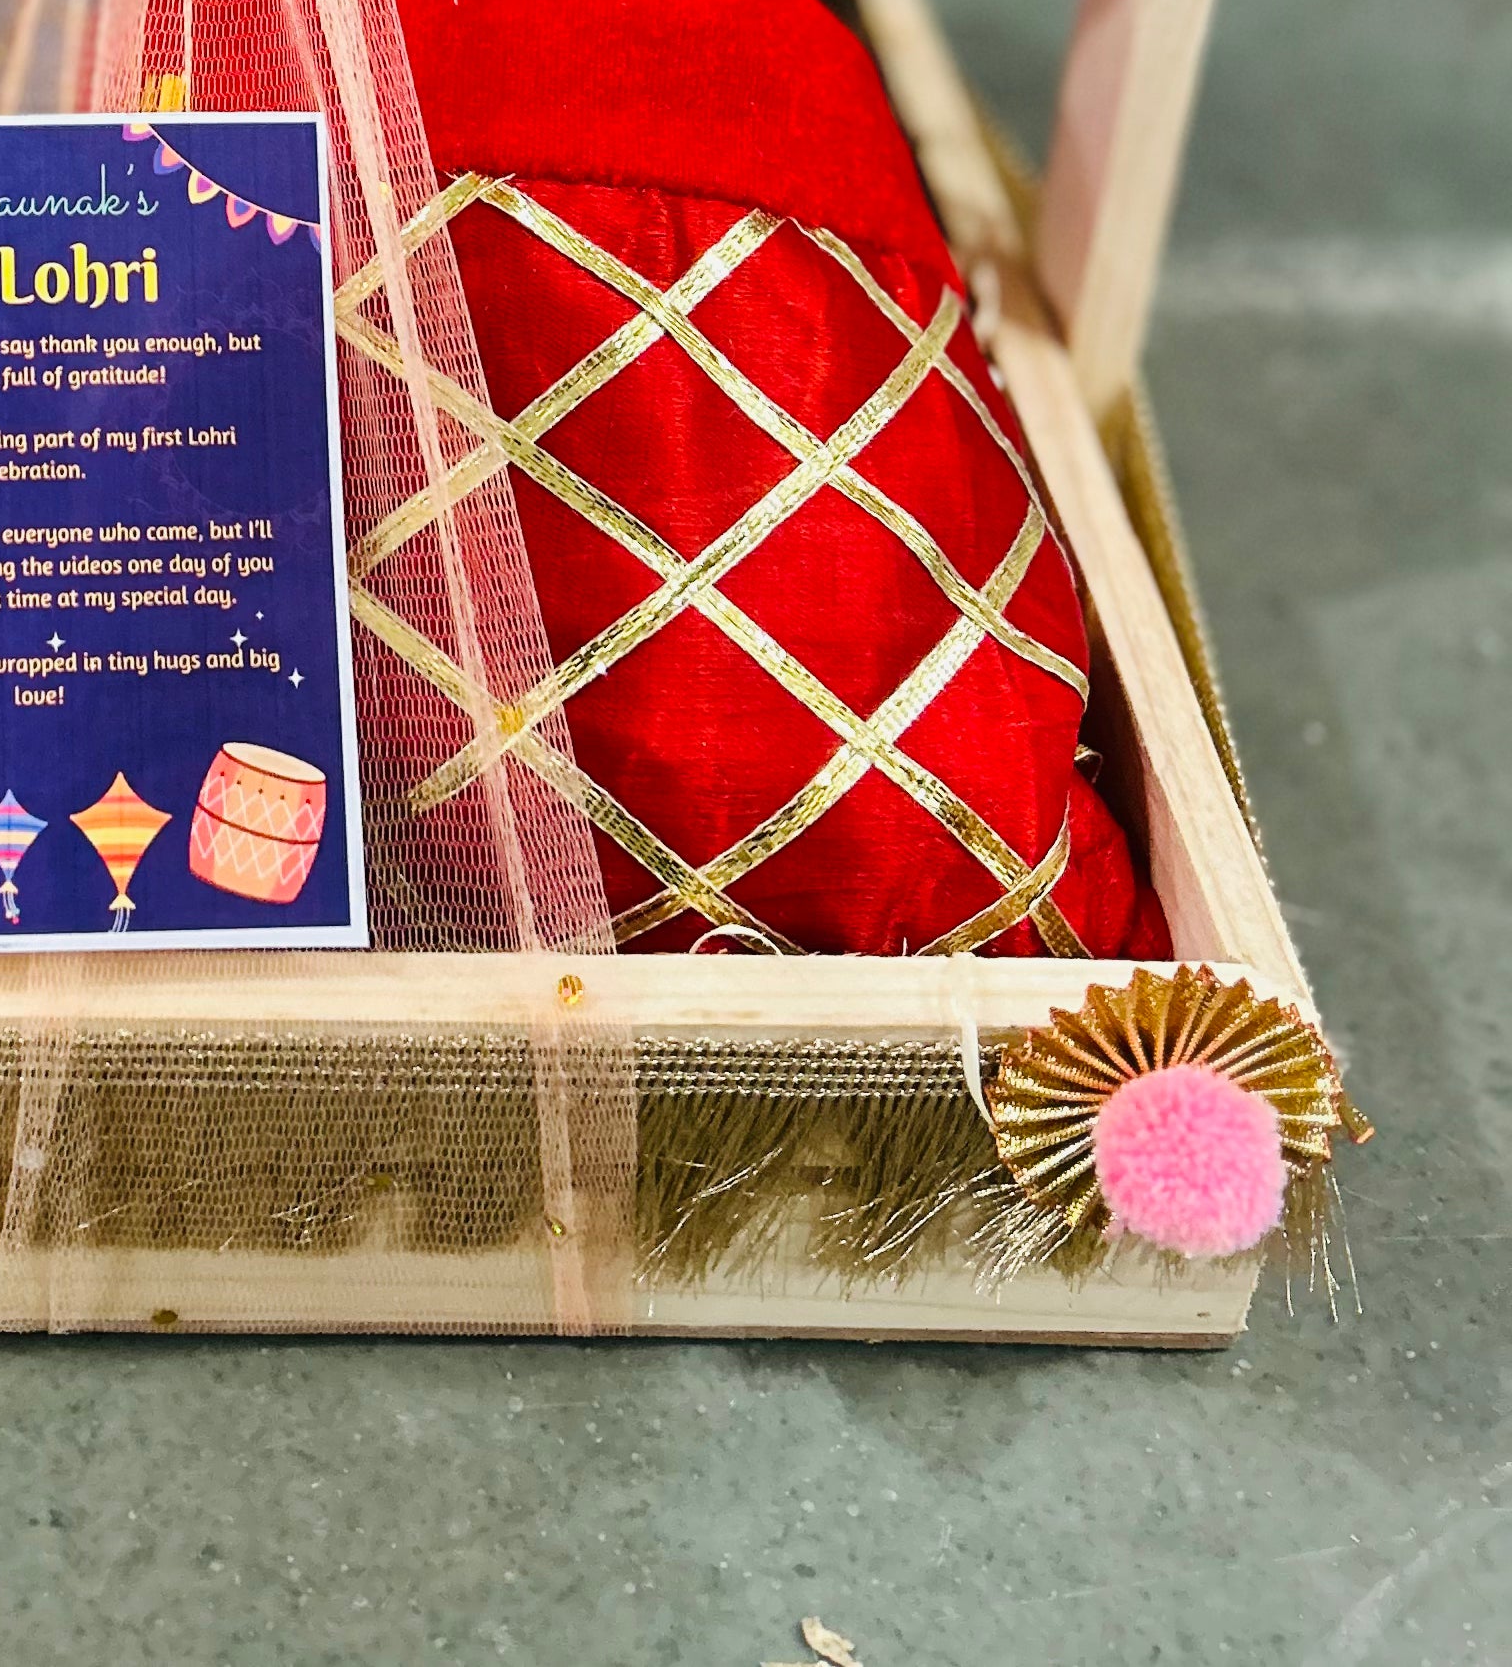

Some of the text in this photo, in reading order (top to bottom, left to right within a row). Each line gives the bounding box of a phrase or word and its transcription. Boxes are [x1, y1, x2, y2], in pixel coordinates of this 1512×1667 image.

[0, 340, 34, 359] say
[39, 334, 97, 354] thank
[104, 338, 140, 357] you
[145, 333, 222, 356] enough,
[229, 333, 261, 351] but
[2, 367, 37, 391] full
[43, 367, 63, 390] of
[68, 365, 166, 390] gratitude!
[34, 431, 75, 453] part
[80, 428, 101, 452] of
[107, 432, 136, 450] my
[142, 427, 182, 450] first
[189, 426, 236, 445] Lohri
[2, 528, 93, 547] everyone
[100, 522, 140, 541] who
[147, 526, 203, 542] came,
[210, 520, 243, 540] but
[249, 520, 273, 538] I'll
[21, 556, 53, 575] the
[60, 555, 122, 575] videos
[128, 559, 163, 574] one
[169, 554, 206, 577] day
[212, 553, 231, 576] of
[238, 557, 273, 576] you
[7, 589, 52, 608] time
[58, 590, 78, 608] at
[84, 592, 115, 611] my
[122, 586, 188, 609] special
[194, 585, 236, 609] day.
[84, 652, 101, 672] in
[108, 652, 147, 675] tiny
[154, 650, 200, 673] hugs
[206, 651, 244, 668] and
[250, 648, 280, 672] big
[15, 686, 64, 705] love!
